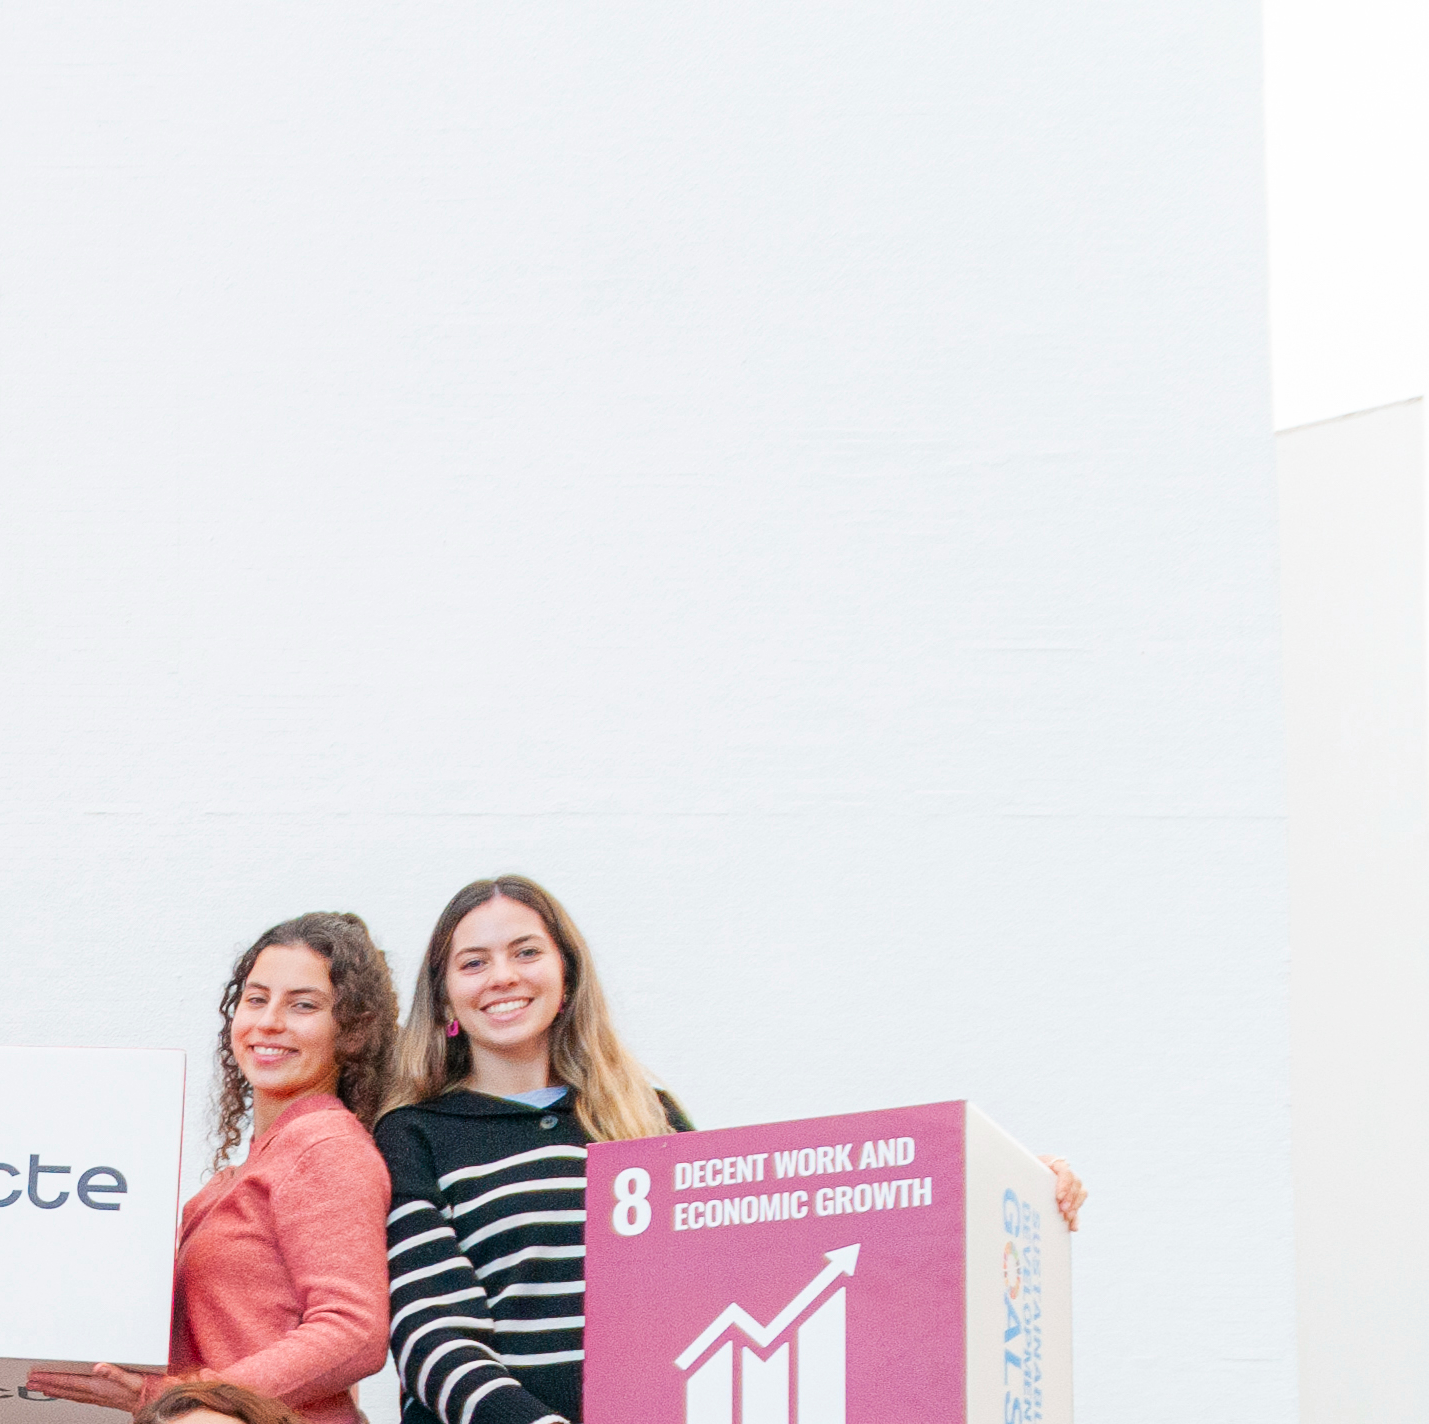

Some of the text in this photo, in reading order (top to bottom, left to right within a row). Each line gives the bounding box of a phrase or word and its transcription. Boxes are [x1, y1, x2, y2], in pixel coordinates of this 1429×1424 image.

[673, 1136, 916, 1191] DECENT WORK AND
[611, 1167, 652, 1237] 8
[673, 1177, 933, 1232] ECONOMIC GROWTH
